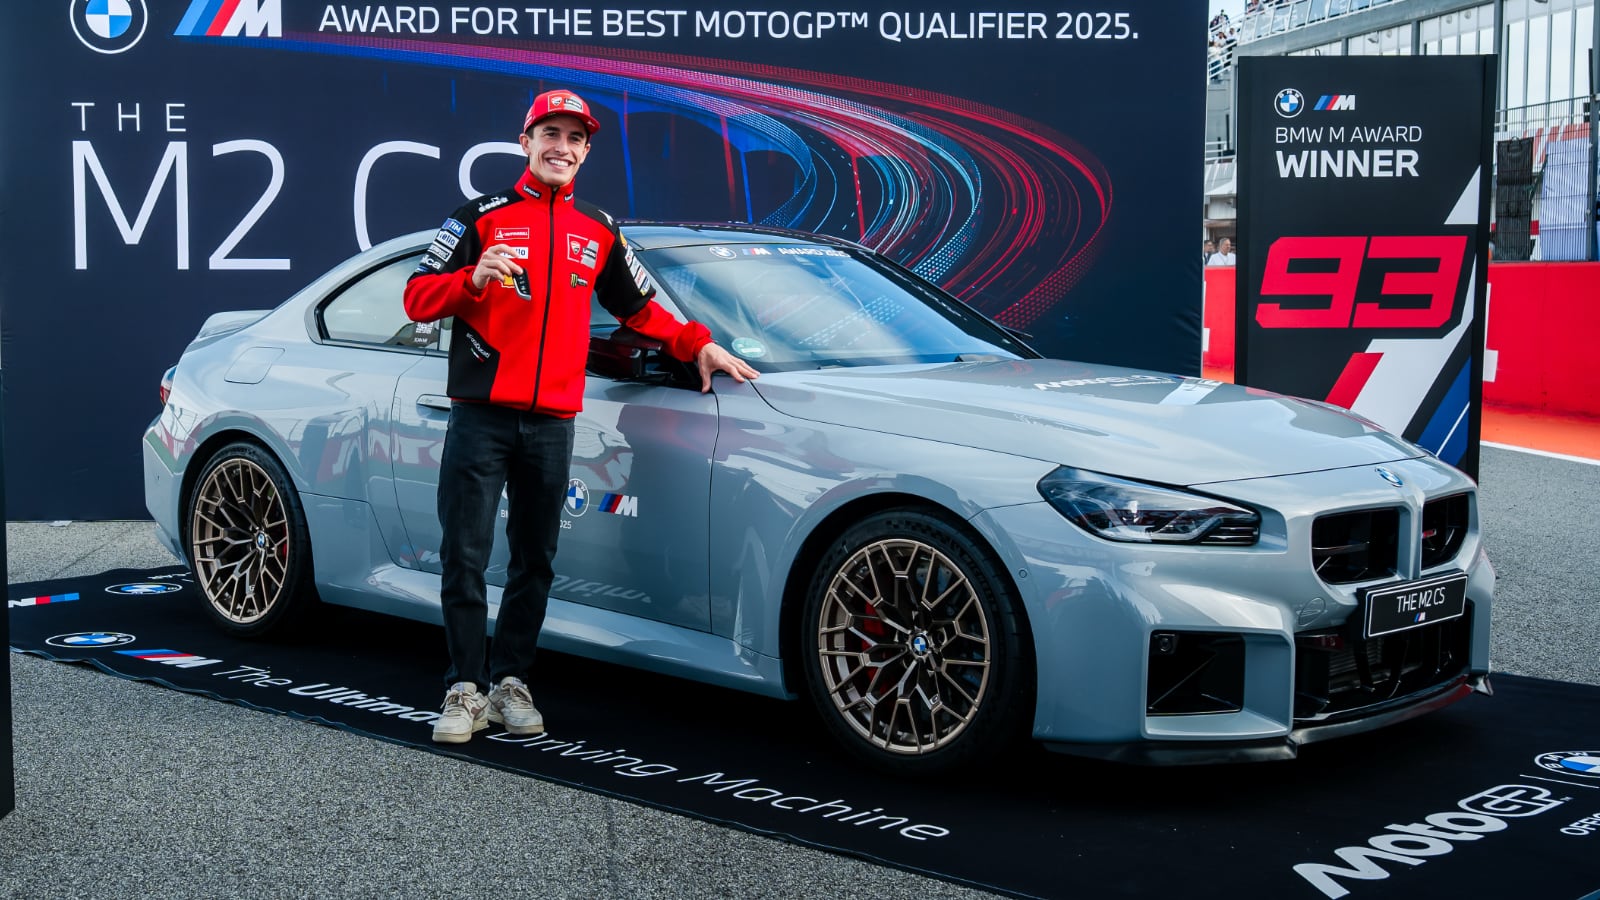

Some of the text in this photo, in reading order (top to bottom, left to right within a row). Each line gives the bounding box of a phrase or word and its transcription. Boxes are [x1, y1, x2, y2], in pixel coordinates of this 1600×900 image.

[318, 5, 440, 34] AWARD
[451, 7, 519, 35] FOR
[525, 8, 593, 36] THE
[602, 9, 688, 37] BEST
[879, 12, 1048, 42] QUALIFIER
[1055, 12, 1139, 40] 2025.
[71, 102, 187, 132] THE
[1275, 126, 1422, 144] BMW M AWARD
[1275, 149, 1420, 178] WINNER
[72, 138, 291, 271] M2
[1255, 235, 1468, 328] 93
[1396, 586, 1446, 613] THE M2 CS
[212, 665, 293, 688] The
[287, 682, 444, 726] Ultima
[486, 731, 679, 778] Driving
[676, 772, 951, 841] Machine
